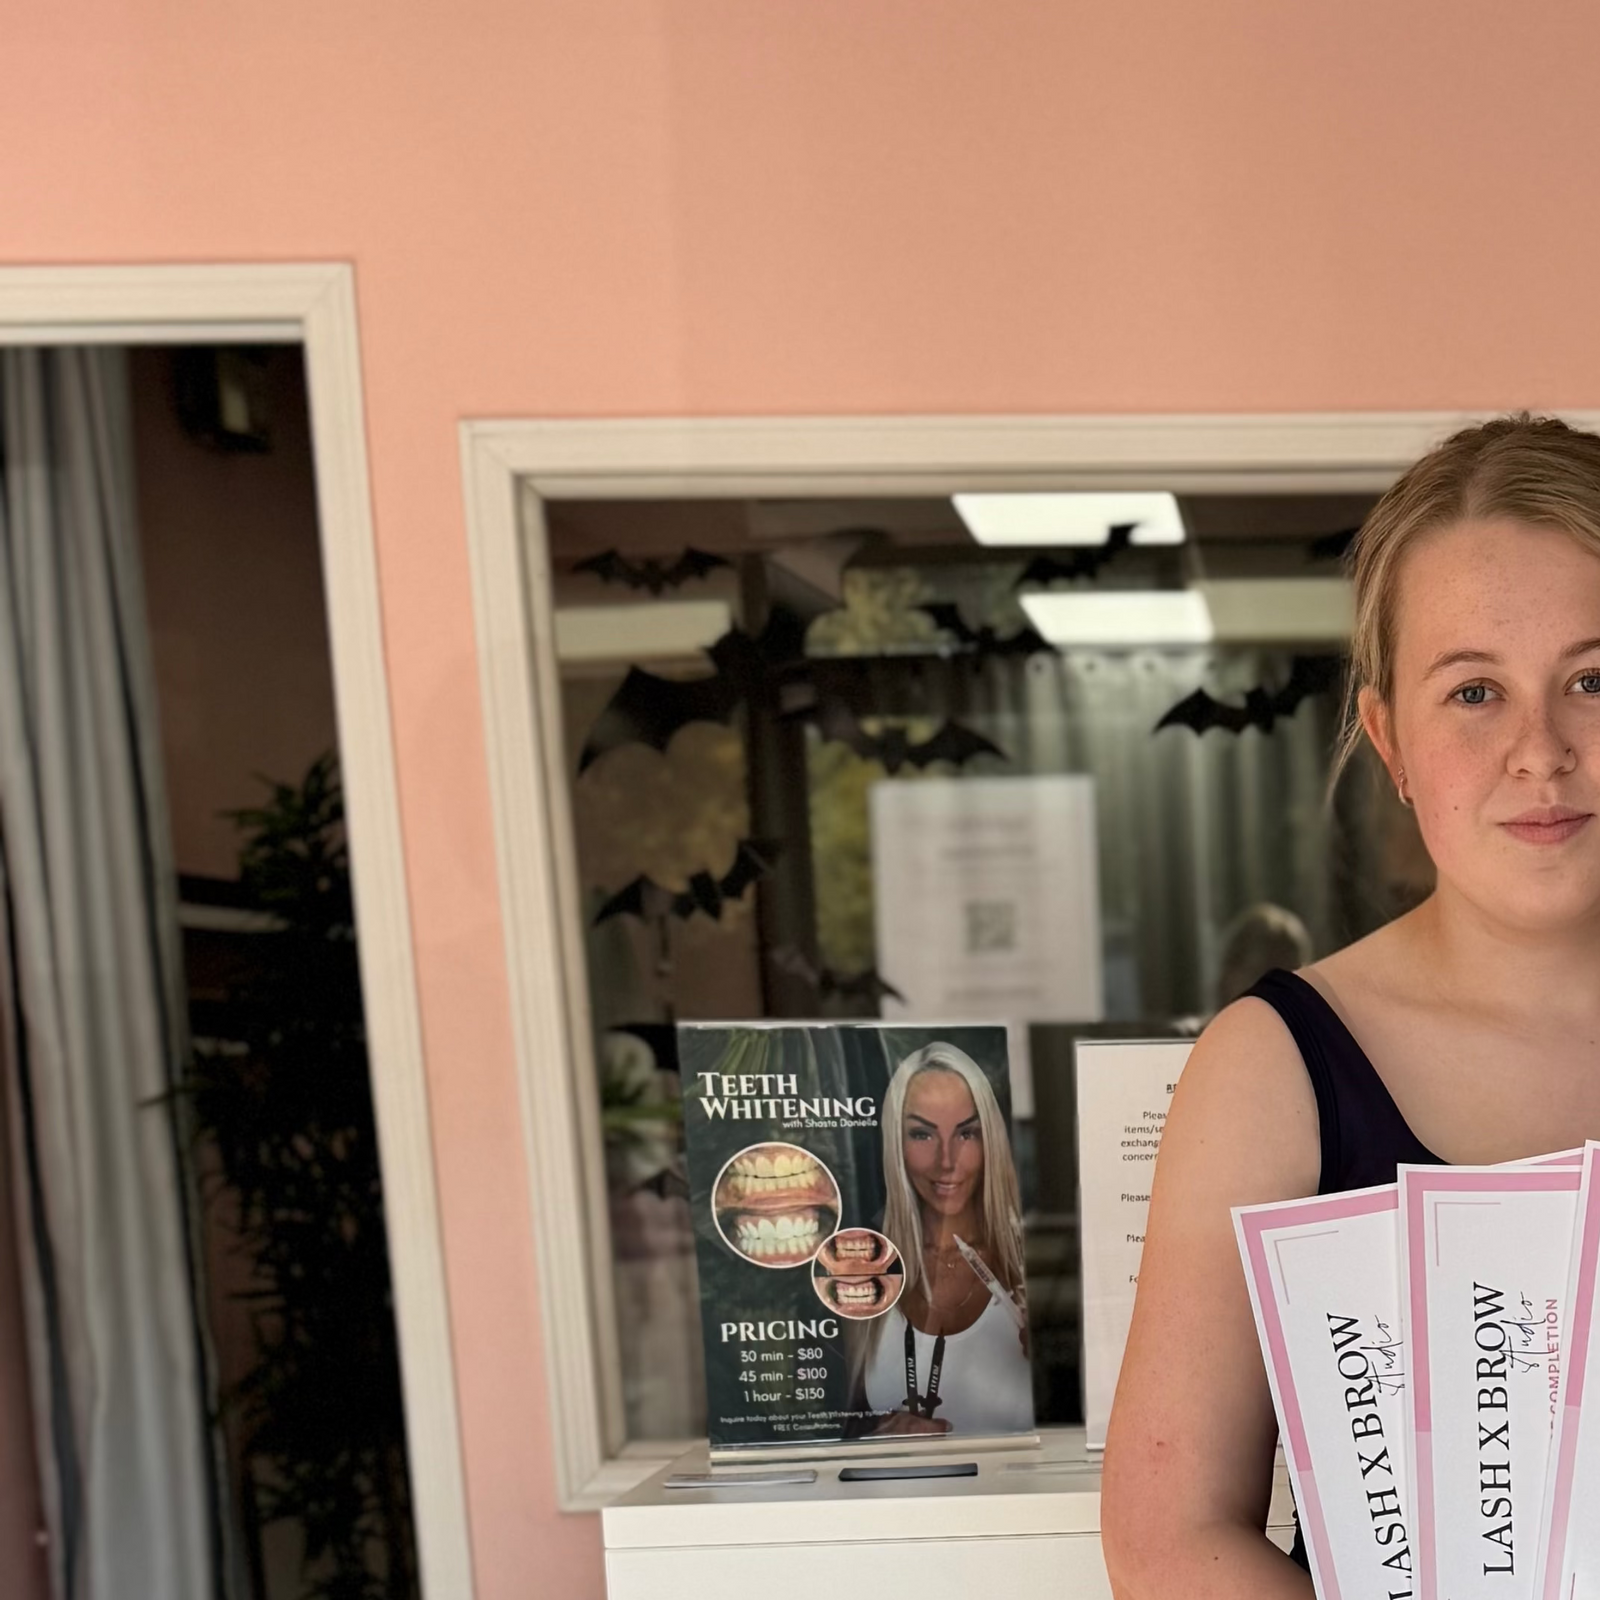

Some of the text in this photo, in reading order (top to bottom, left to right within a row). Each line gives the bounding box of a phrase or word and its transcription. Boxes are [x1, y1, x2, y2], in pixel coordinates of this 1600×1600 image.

[697, 1072, 798, 1096] TEETH
[699, 1096, 876, 1120] WHITENING
[783, 1119, 803, 1128] with
[1121, 1139, 1159, 1149] exchang
[720, 1318, 839, 1342] PRICING
[741, 1350, 757, 1363] 30
[761, 1350, 784, 1362] min
[798, 1347, 823, 1361] $80
[739, 1370, 757, 1383] 45
[760, 1370, 783, 1382] min
[797, 1366, 828, 1381] $100
[1327, 1313, 1384, 1442] BROW
[744, 1390, 749, 1402] 1
[753, 1389, 782, 1402] hour
[746, 1414, 767, 1423] today
[768, 1413, 790, 1421] about
[791, 1413, 806, 1422] your
[1473, 1282, 1515, 1576] LASH X BROW
[1357, 1446, 1393, 1480] X
